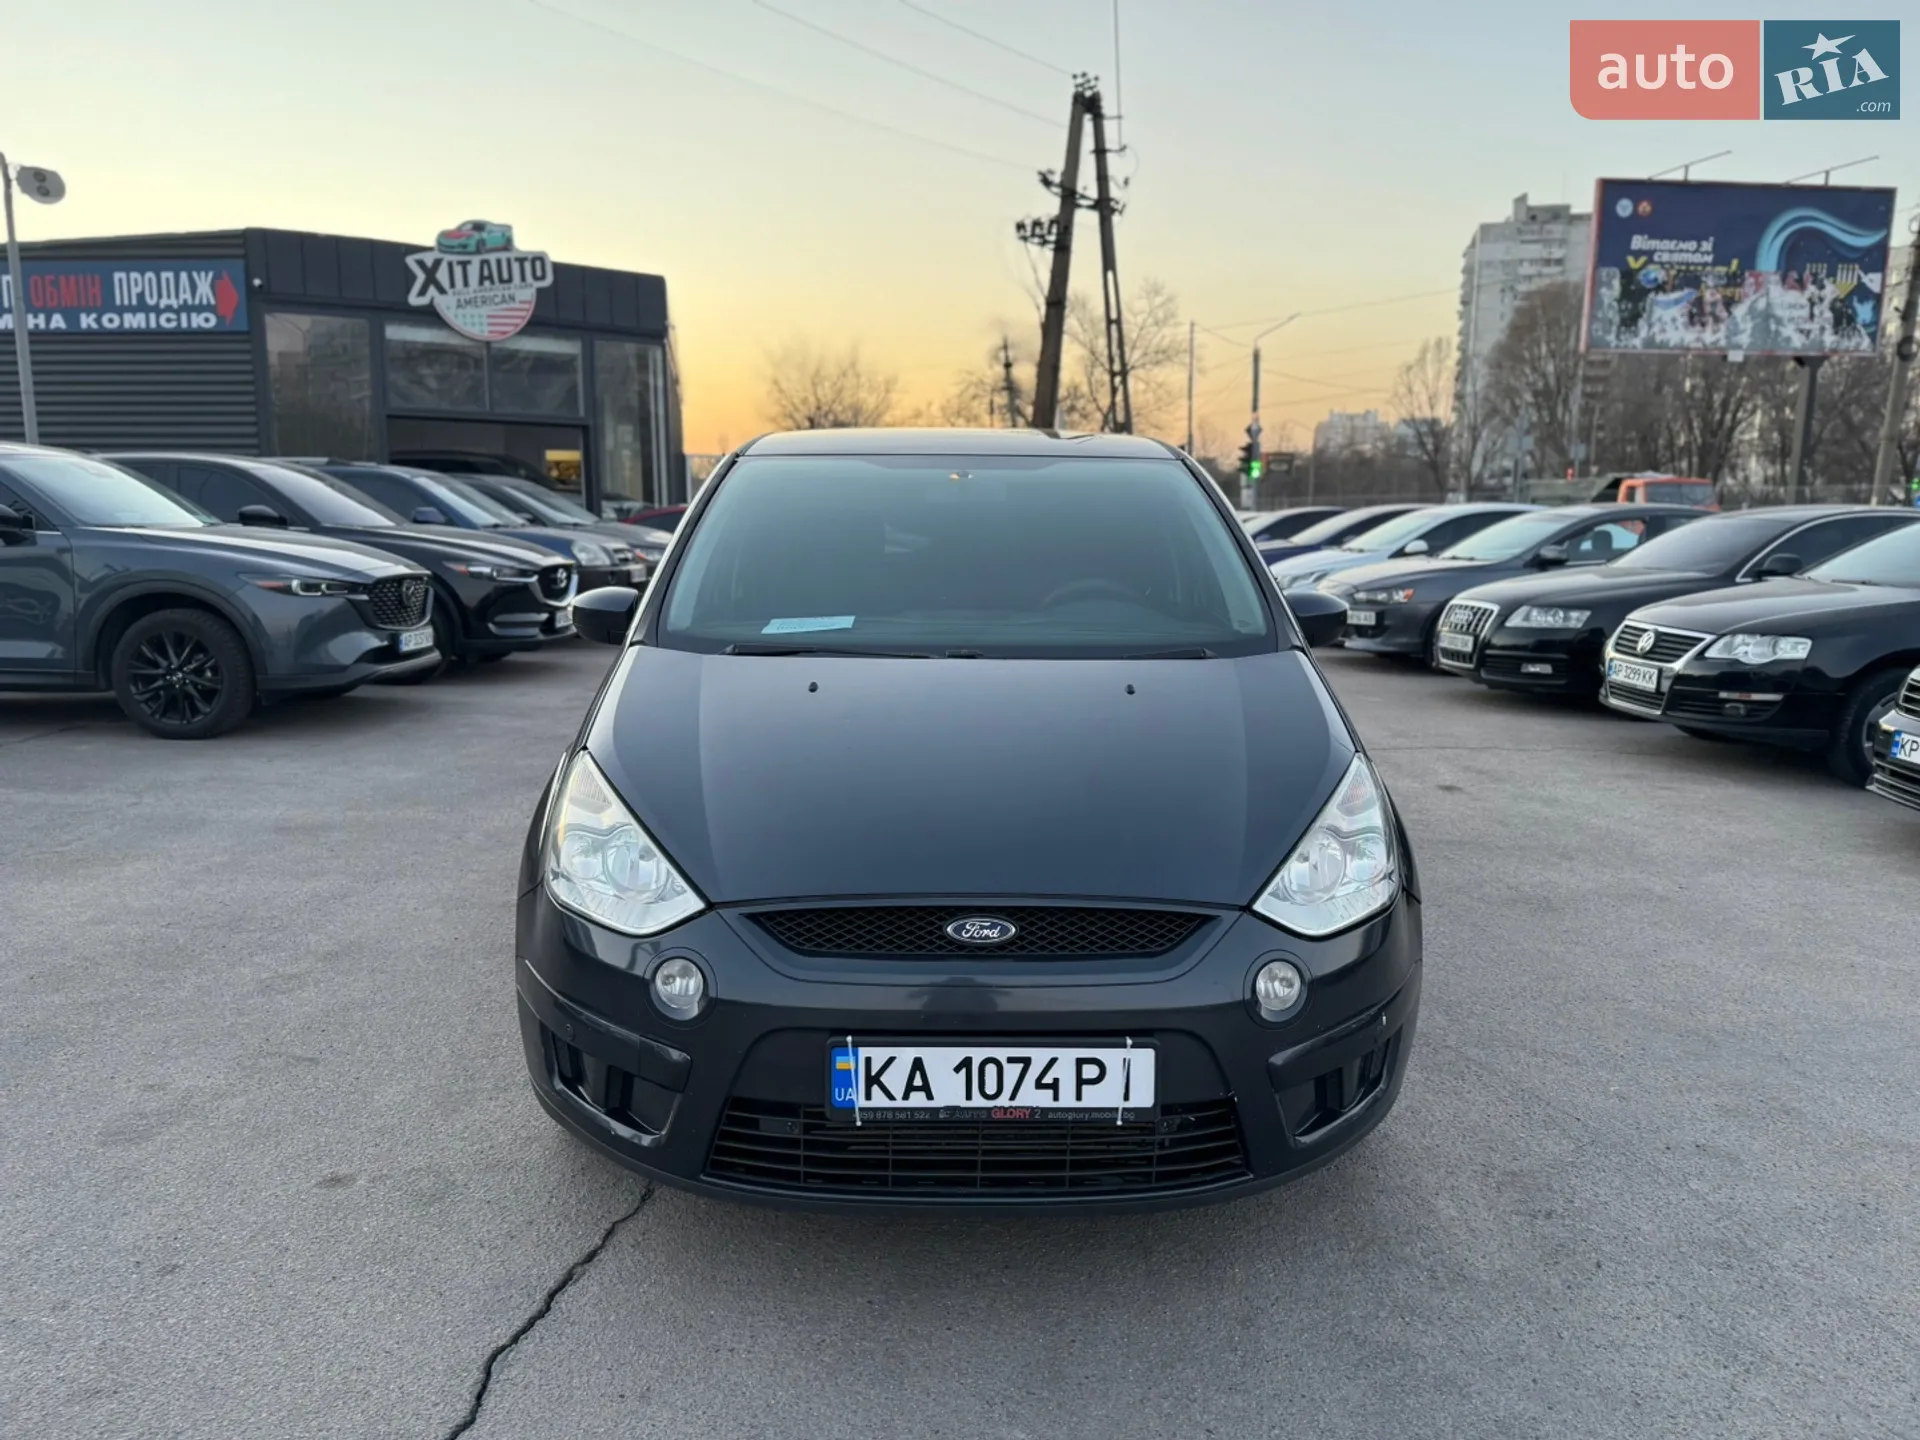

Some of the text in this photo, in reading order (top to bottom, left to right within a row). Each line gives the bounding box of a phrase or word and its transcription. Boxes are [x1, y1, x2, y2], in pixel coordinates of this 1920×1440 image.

[1630, 233, 1715, 252] Вітаємо зі
[1653, 251, 1715, 264] святом
[478, 256, 547, 286] AUTO
[29, 274, 102, 309] ОБМІН
[113, 270, 216, 309] ПРОДАЖ
[456, 292, 517, 309] AMERICAN
[27, 313, 67, 330] НА
[80, 312, 218, 330] КОМІСІЮ
[1642, 670, 1656, 686] KK
[1899, 737, 1920, 758] KP
[962, 921, 1002, 938] Ford
[864, 1056, 935, 1102] KA
[952, 1056, 1061, 1102] 1074
[834, 1087, 856, 1102] UA
[991, 1108, 1031, 1119] GLORY
[1034, 1109, 1041, 1119] 2
